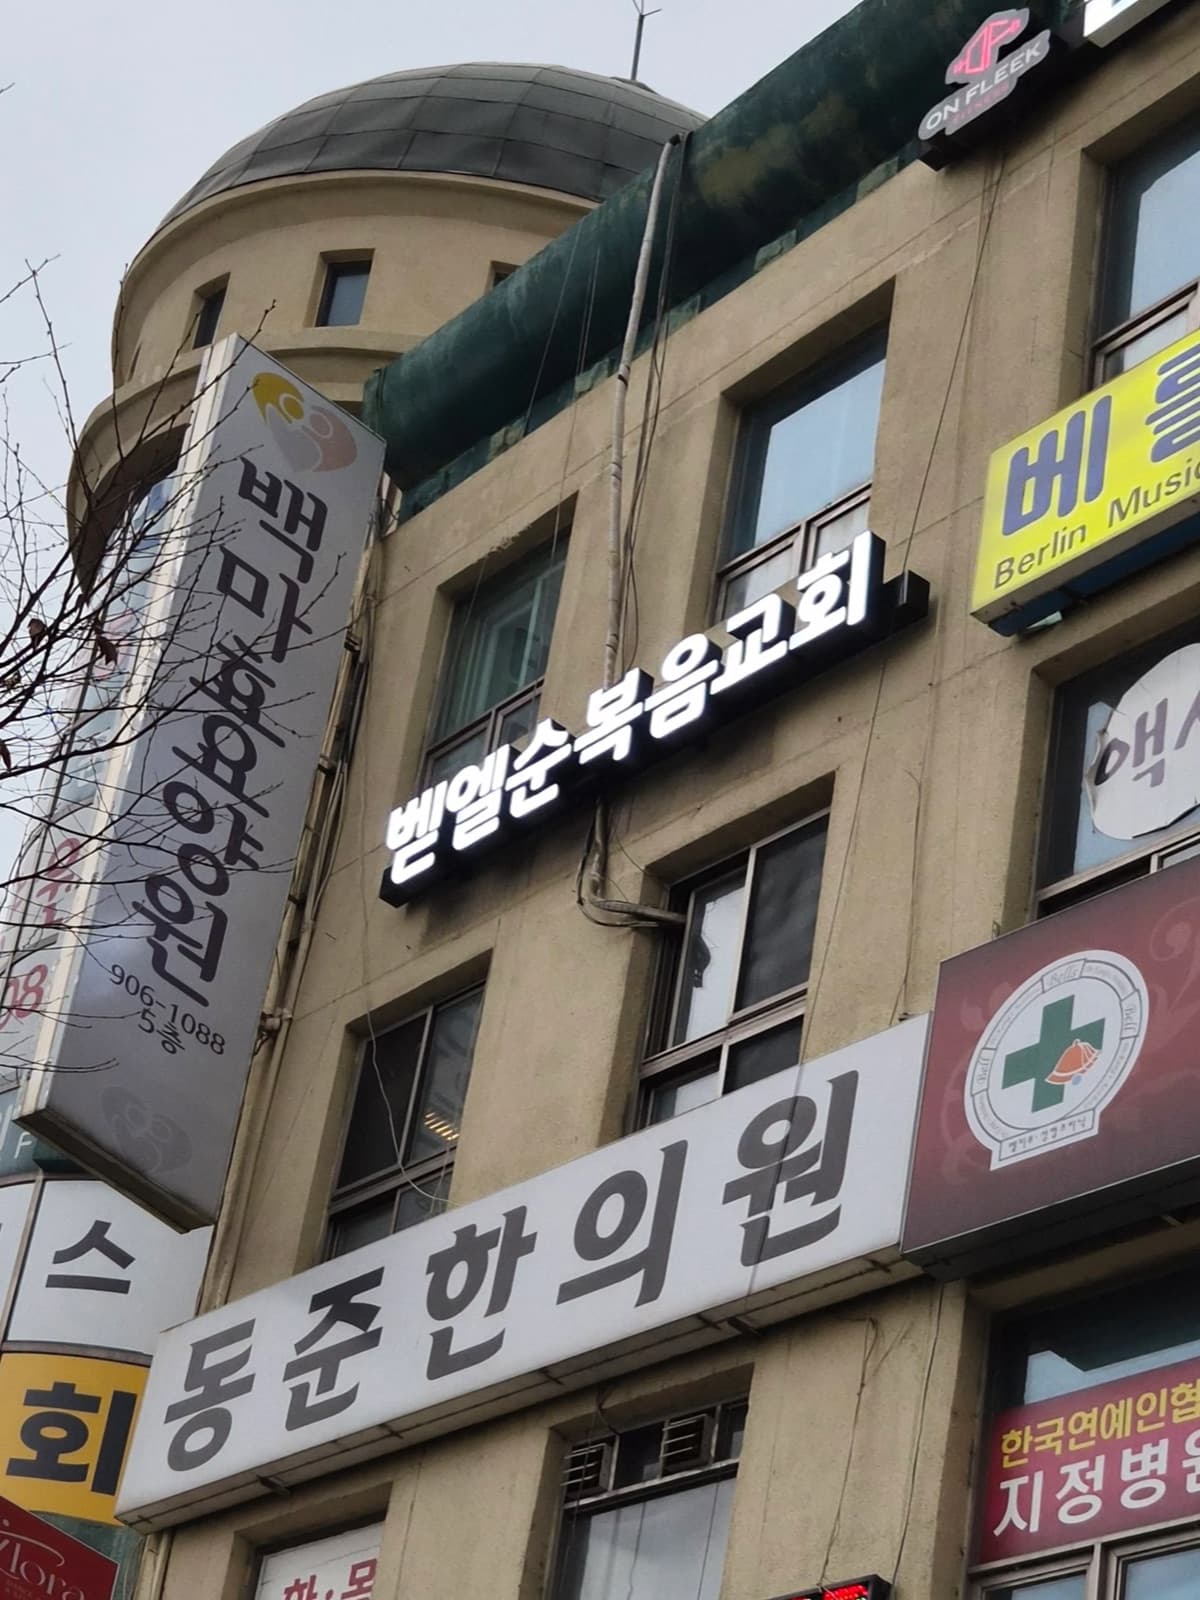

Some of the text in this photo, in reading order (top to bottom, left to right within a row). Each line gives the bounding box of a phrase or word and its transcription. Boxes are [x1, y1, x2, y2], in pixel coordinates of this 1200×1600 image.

[926, 99, 960, 131] ON
[965, 43, 1041, 105] FLEEK
[993, 522, 1087, 592] Berlin
[385, 529, 873, 886] 벧엘순복음교회
[109, 963, 226, 1056] 906-1088
[138, 1010, 185, 1055] 5층
[163, 1069, 859, 1472] 동준한의원
[5, 1381, 137, 1497] 회
